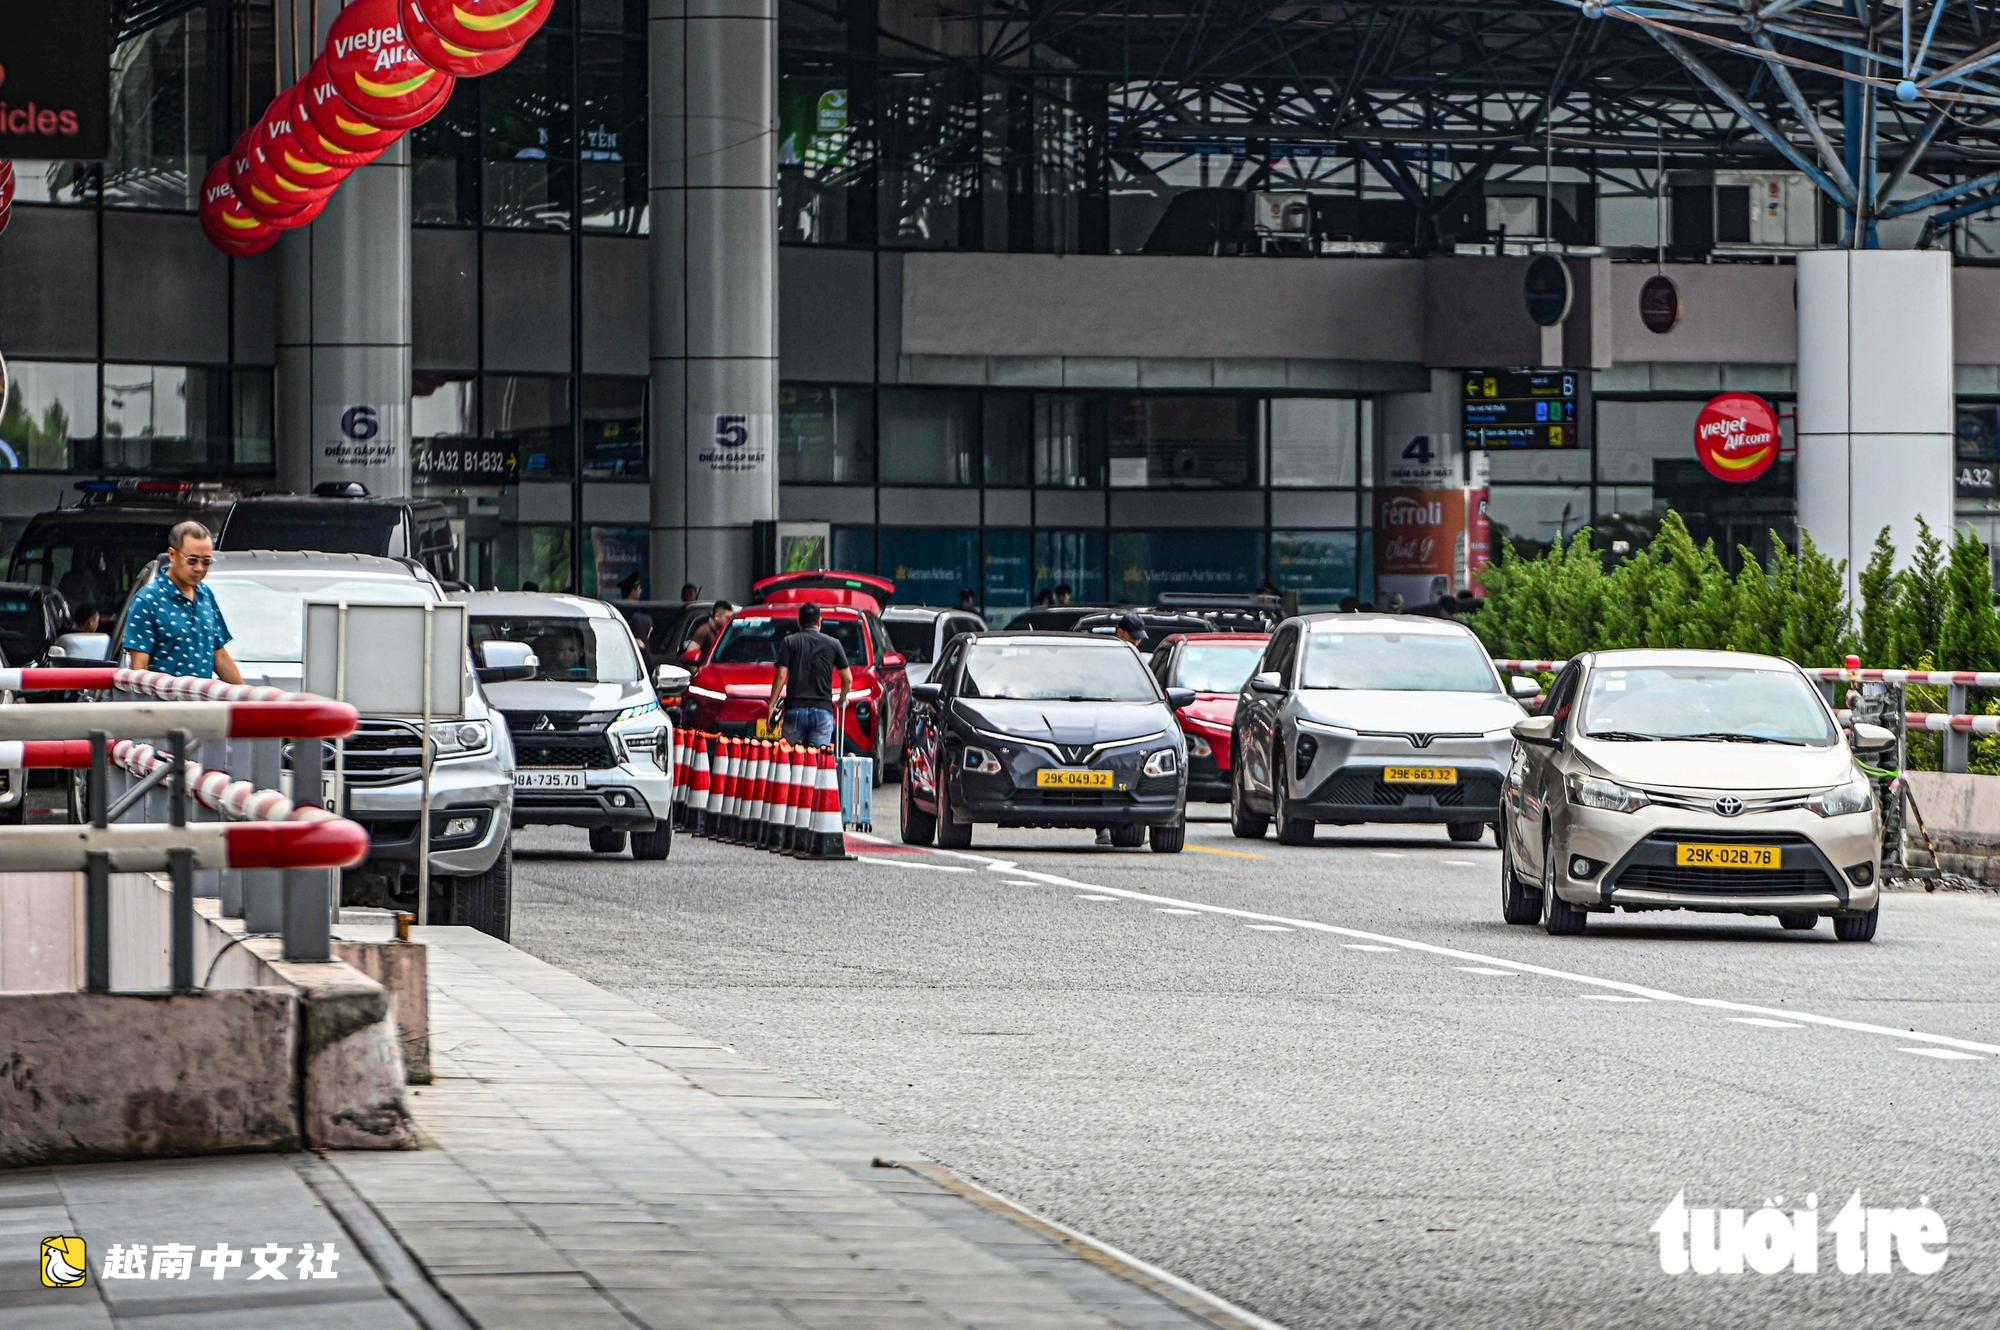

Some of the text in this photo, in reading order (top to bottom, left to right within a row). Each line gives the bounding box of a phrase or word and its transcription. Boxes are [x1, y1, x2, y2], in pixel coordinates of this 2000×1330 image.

[341, 405, 378, 440] 6
[715, 415, 748, 448] 5
[1401, 435, 1435, 464] 4
[1723, 432, 1770, 451] Air.com
[418, 450, 504, 472] A1-A32 B1-B32
